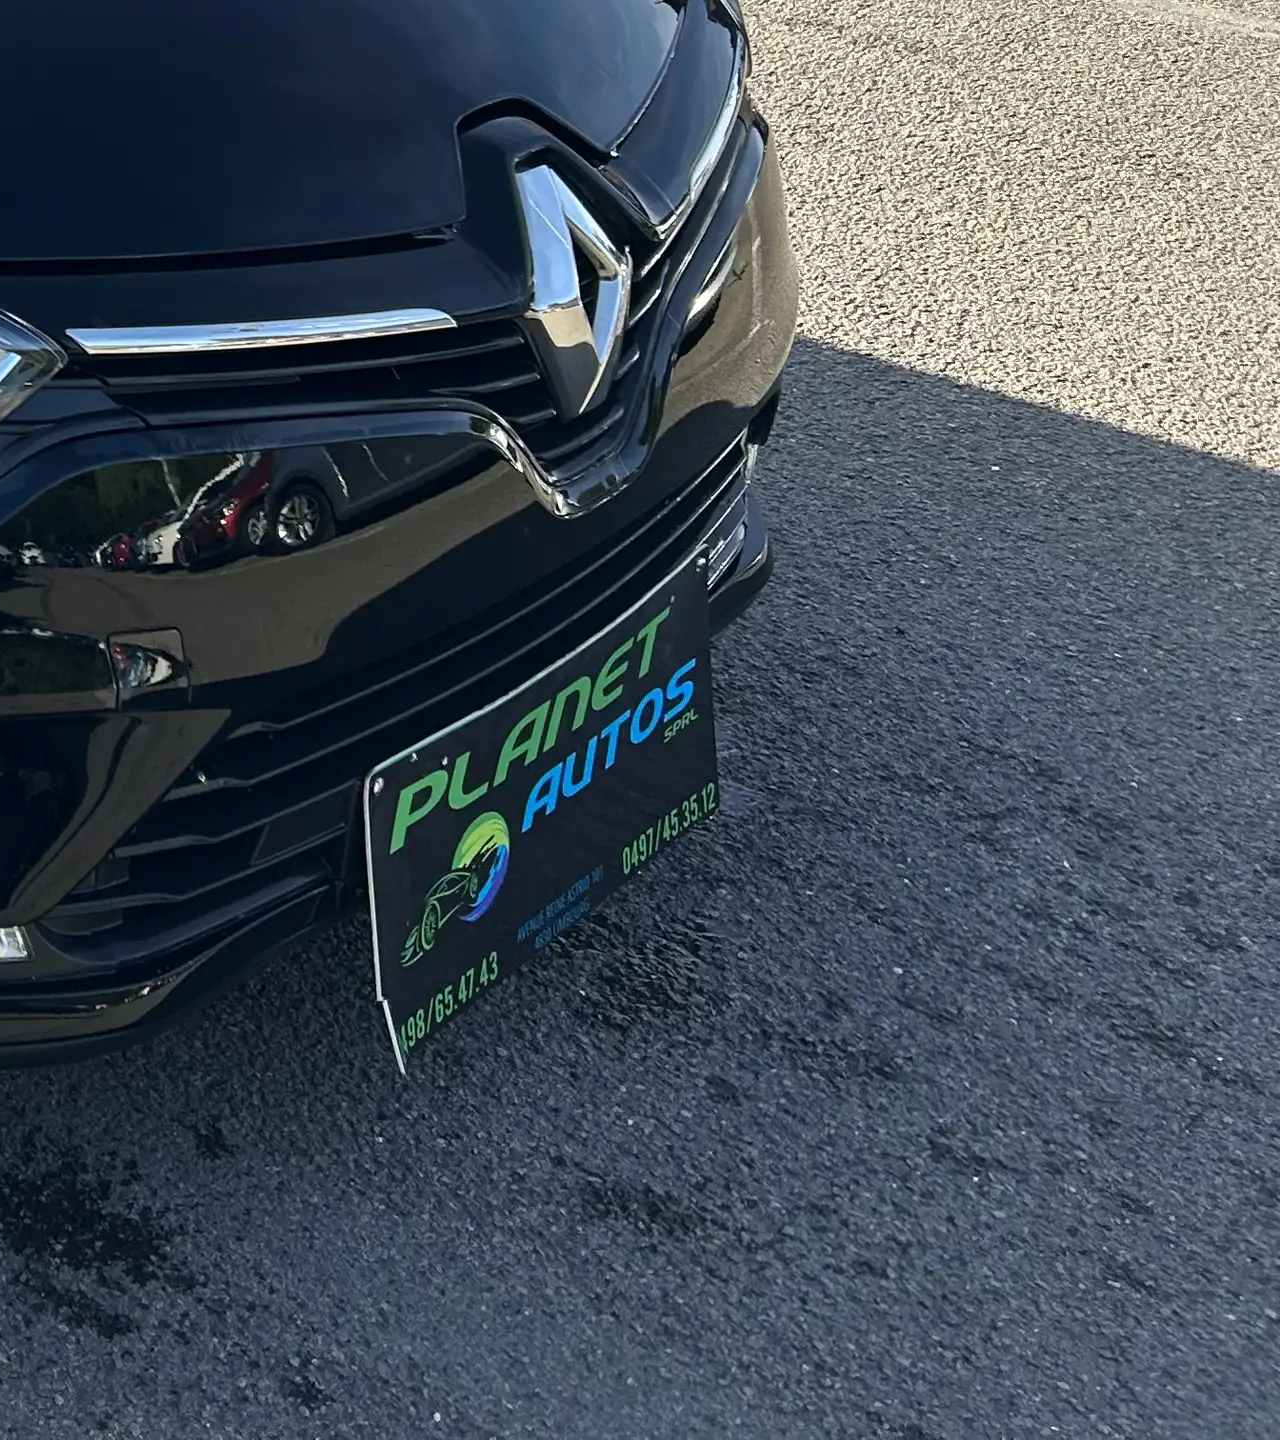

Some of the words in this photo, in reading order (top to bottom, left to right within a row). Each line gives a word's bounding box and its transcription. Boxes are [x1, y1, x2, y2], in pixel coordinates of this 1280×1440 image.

[389, 606, 672, 855] PLANET
[521, 658, 697, 834] AUTOS
[663, 708, 700, 744] SPRL
[622, 782, 716, 875] 0497/45.35.12
